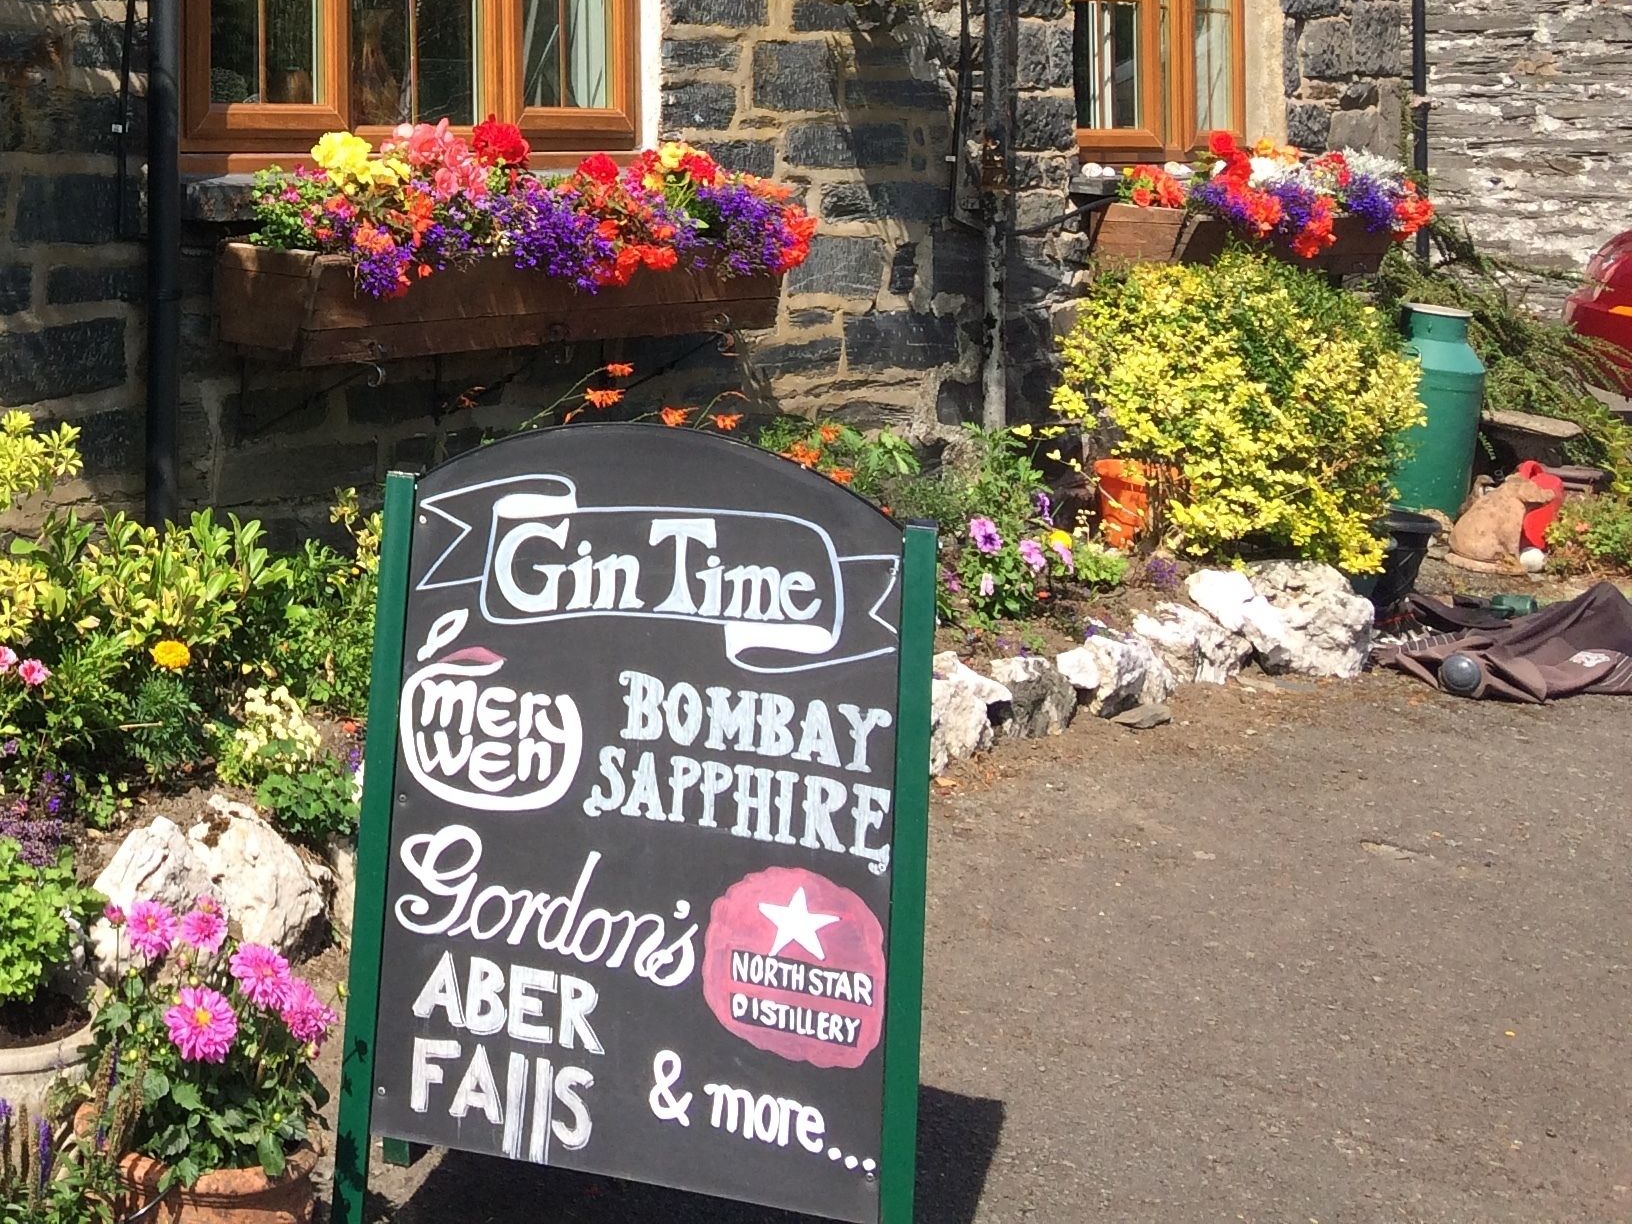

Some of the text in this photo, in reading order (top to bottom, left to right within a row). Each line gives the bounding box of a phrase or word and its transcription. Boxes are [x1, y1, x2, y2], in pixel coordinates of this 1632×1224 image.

[494, 517, 822, 621] Gin Time
[618, 670, 893, 773] BOMBAY
[583, 745, 891, 875] SAPPHIRE
[394, 824, 699, 986] Gordon's
[412, 950, 605, 1055] ABER
[732, 951, 873, 1006] NORTH STAR
[732, 993, 861, 1043] DISTILLERY
[648, 1049, 876, 1170] & more...
